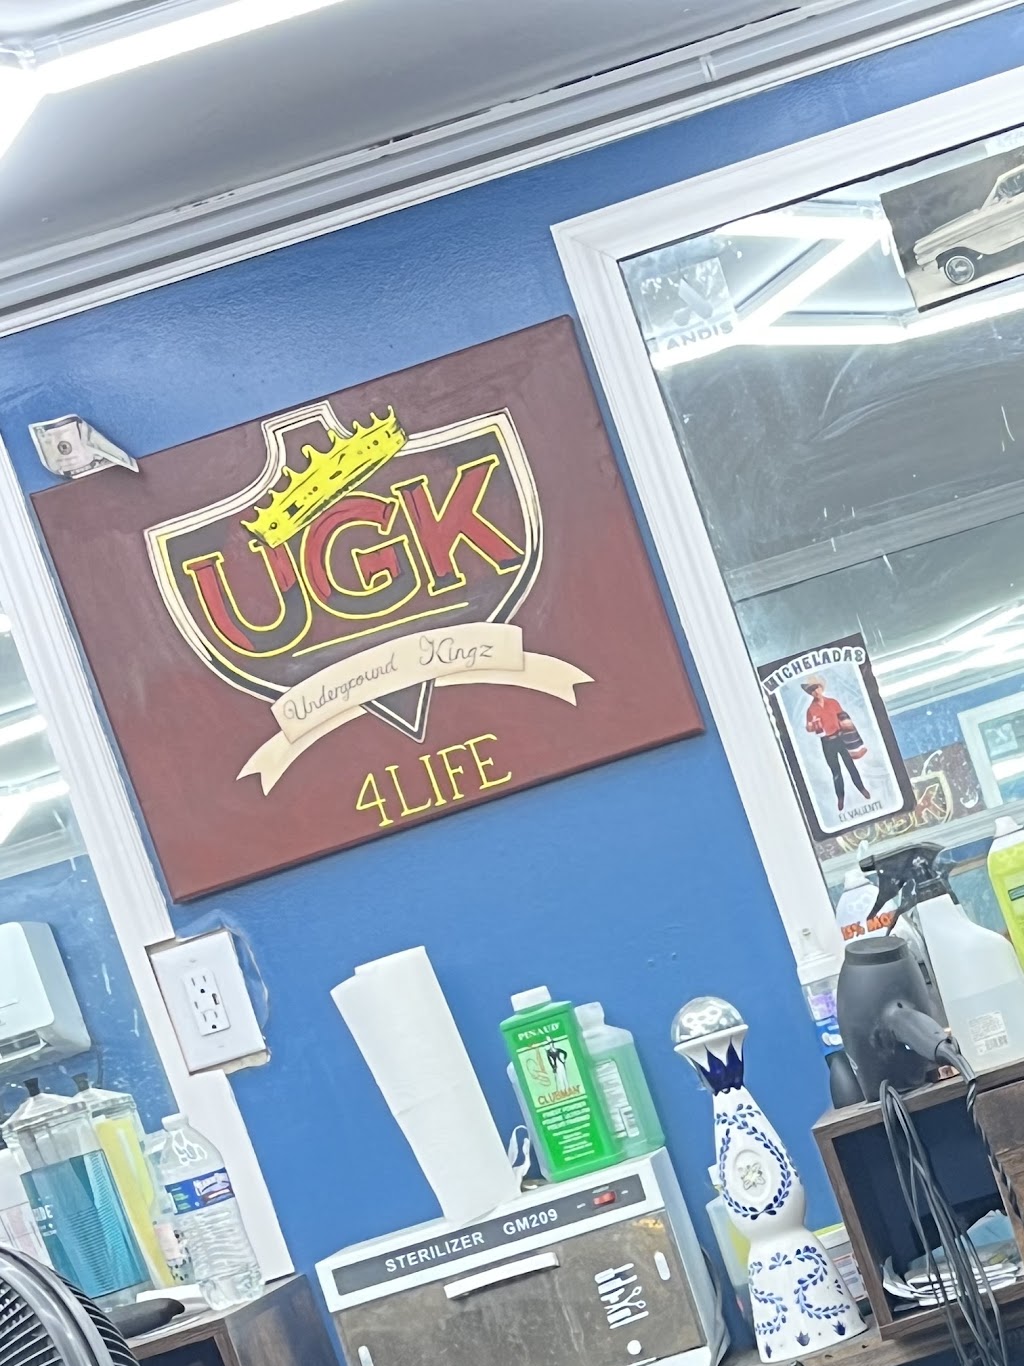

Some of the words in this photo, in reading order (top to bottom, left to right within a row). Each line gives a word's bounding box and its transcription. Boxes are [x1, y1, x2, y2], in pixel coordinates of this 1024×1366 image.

[666, 320, 734, 350] ANDIS
[182, 453, 526, 658] UGK
[418, 635, 494, 668] Kingz
[763, 649, 865, 691] MICHELADAS
[355, 733, 513, 828] 4LIFE
[838, 812, 849, 823] EL
[384, 1231, 485, 1273] STERILIZER
[502, 1208, 559, 1236] GM209
